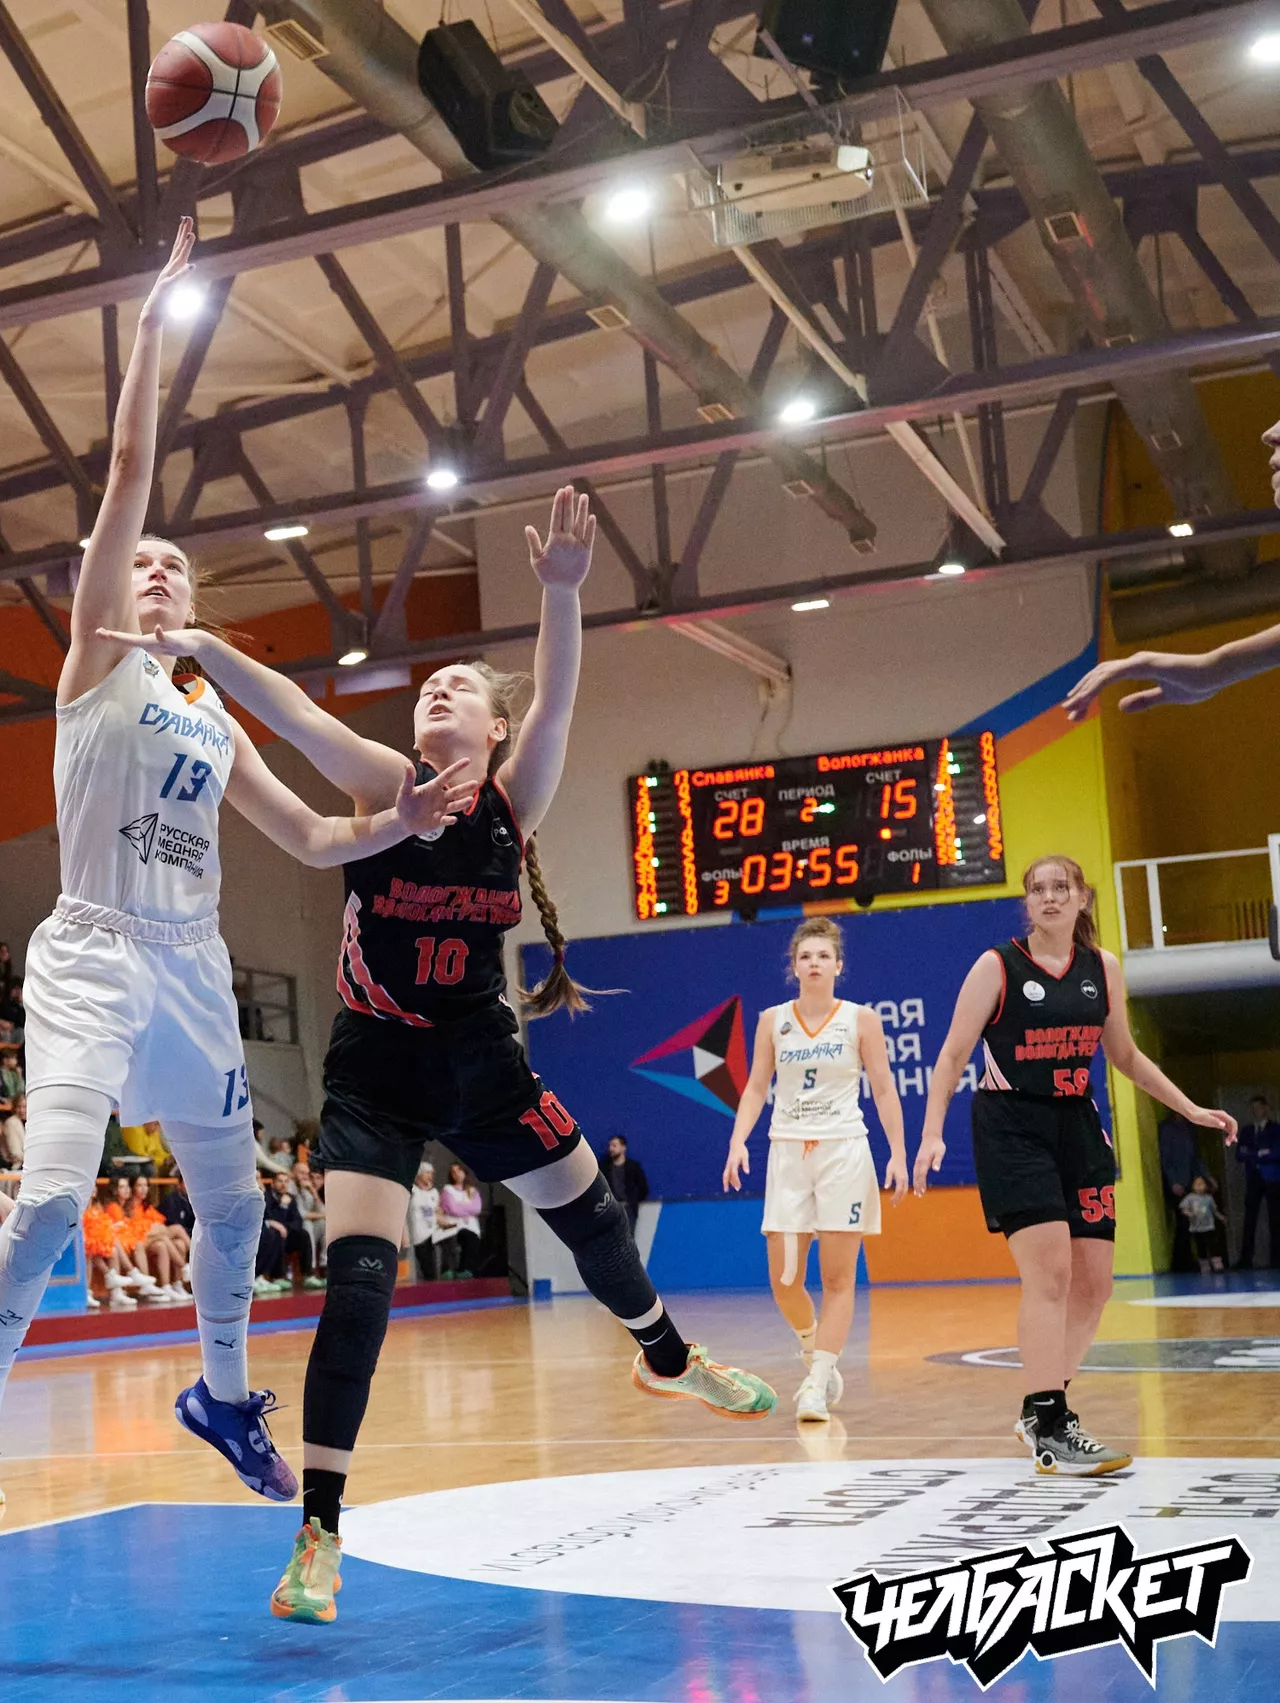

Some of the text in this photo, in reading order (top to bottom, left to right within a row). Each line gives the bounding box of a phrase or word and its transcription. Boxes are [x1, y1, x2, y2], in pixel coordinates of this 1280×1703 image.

[138, 702, 230, 759] СЛАВЯНКА
[817, 746, 925, 772] Вологжанка
[159, 752, 213, 803] 13
[691, 765, 776, 788] Славянка
[865, 769, 902, 784] СЧЕТ
[714, 787, 750, 802] СЧЕТ
[778, 783, 836, 801] ПЕРИОД
[880, 777, 917, 819] 15
[713, 797, 766, 840] 28
[800, 797, 819, 823] 2
[158, 836, 204, 863] МЕДНАЯ
[160, 821, 210, 852] РУССКАЯ
[782, 836, 830, 851] ВРЕМЯ
[154, 848, 204, 880] КОМПАНИЯ
[887, 847, 933, 862] ФОЛЫ
[701, 866, 743, 882] ФОЛЫ
[740, 844, 859, 894] 03:55
[911, 861, 920, 884] 1
[713, 879, 730, 905] 3
[415, 936, 469, 985] 10
[779, 1043, 843, 1065] СЛАВЯНКА
[803, 1068, 818, 1090] 5
[518, 1091, 577, 1151] 10
[849, 1202, 862, 1225] 5
[743, 1468, 968, 1529] СПОРТА
